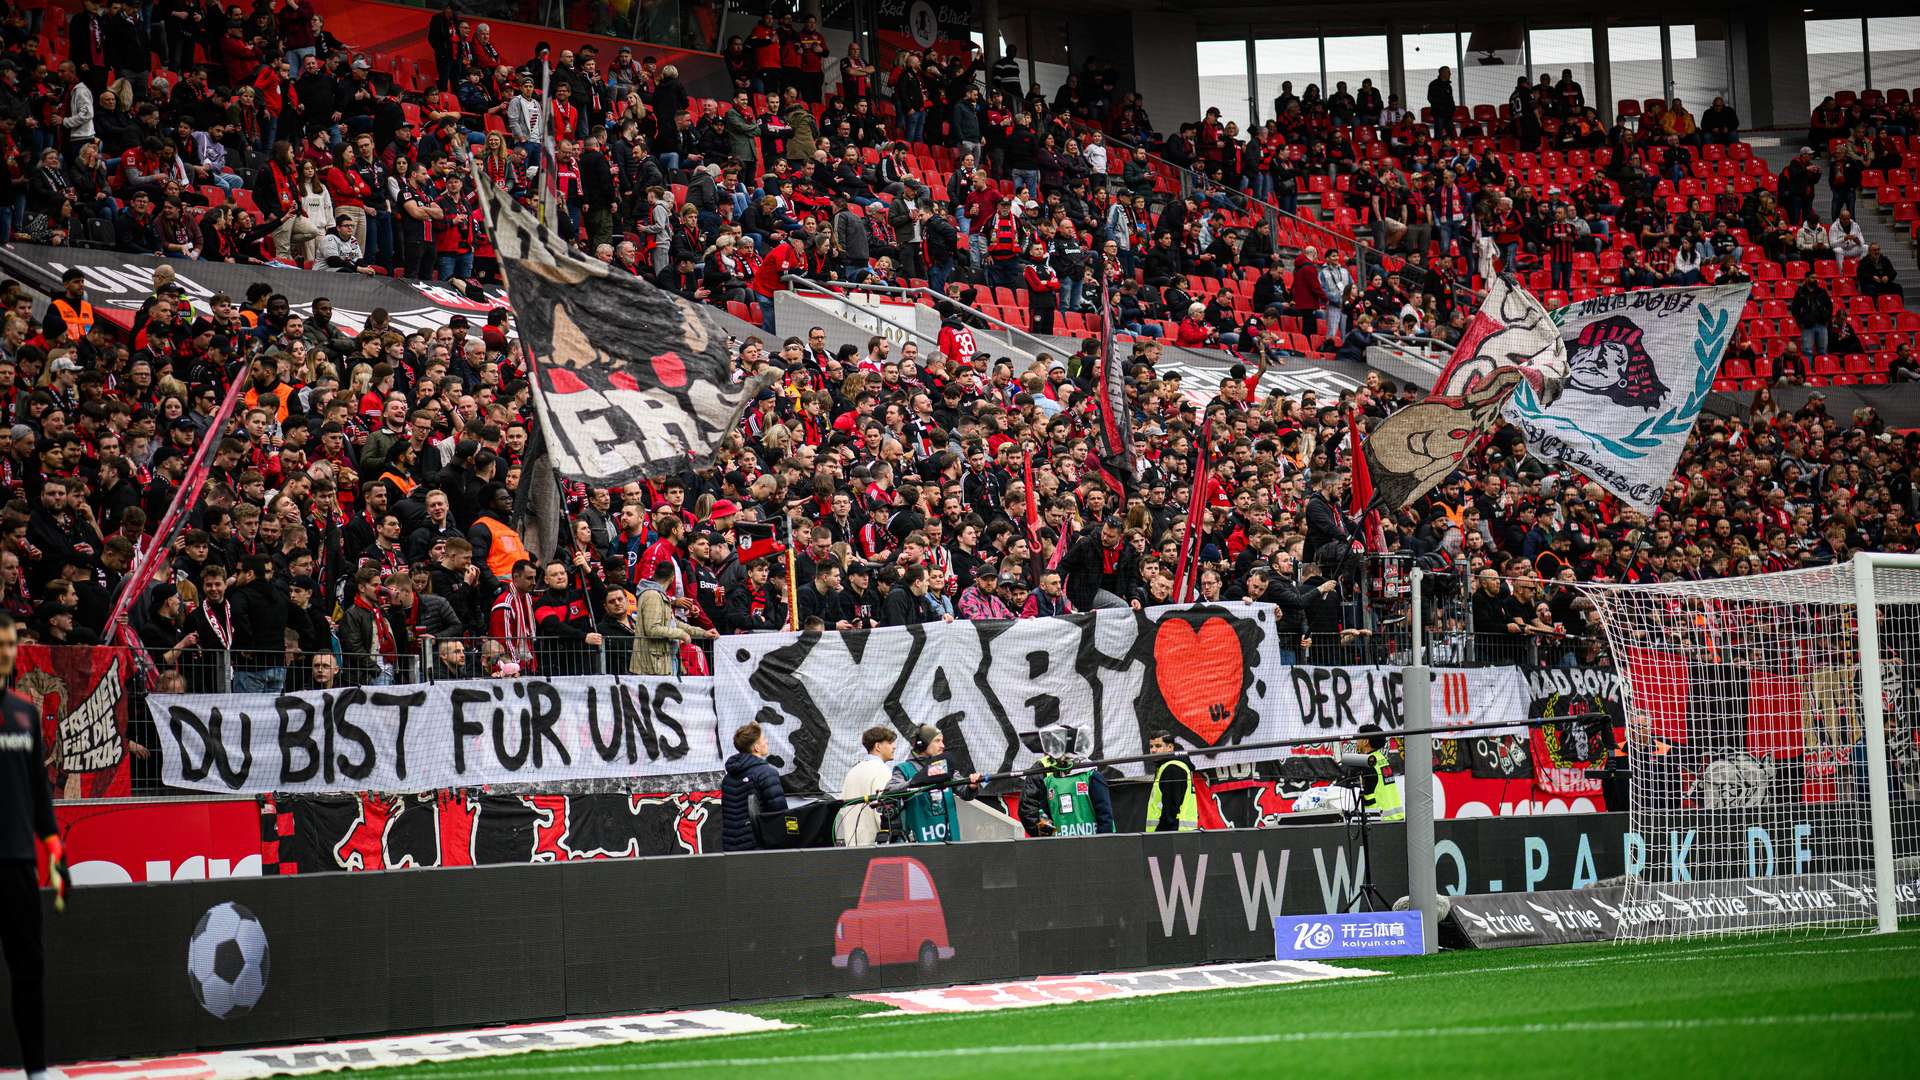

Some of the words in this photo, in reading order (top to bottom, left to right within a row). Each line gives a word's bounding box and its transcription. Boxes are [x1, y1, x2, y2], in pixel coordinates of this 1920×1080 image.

[955, 333, 975, 355] 38
[59, 657, 122, 739] FREIHEIT
[1291, 667, 1357, 729] DER
[1530, 668, 1572, 702] MAD
[62, 728, 91, 756] FÜR
[92, 707, 118, 747] DIE
[168, 705, 253, 790] DU
[275, 688, 427, 784] BIST
[451, 681, 572, 774] FÜR
[587, 682, 690, 764] UNS
[63, 735, 123, 771] ULTRAS
[1692, 892, 1749, 919] trive
[1780, 886, 1837, 912] trive
[1487, 908, 1536, 935] trive
[1558, 904, 1602, 931] trive
[1621, 900, 1666, 927] trive
[1341, 922, 1405, 939] 开云体育
[1342, 938, 1406, 949] kaiyun.com
